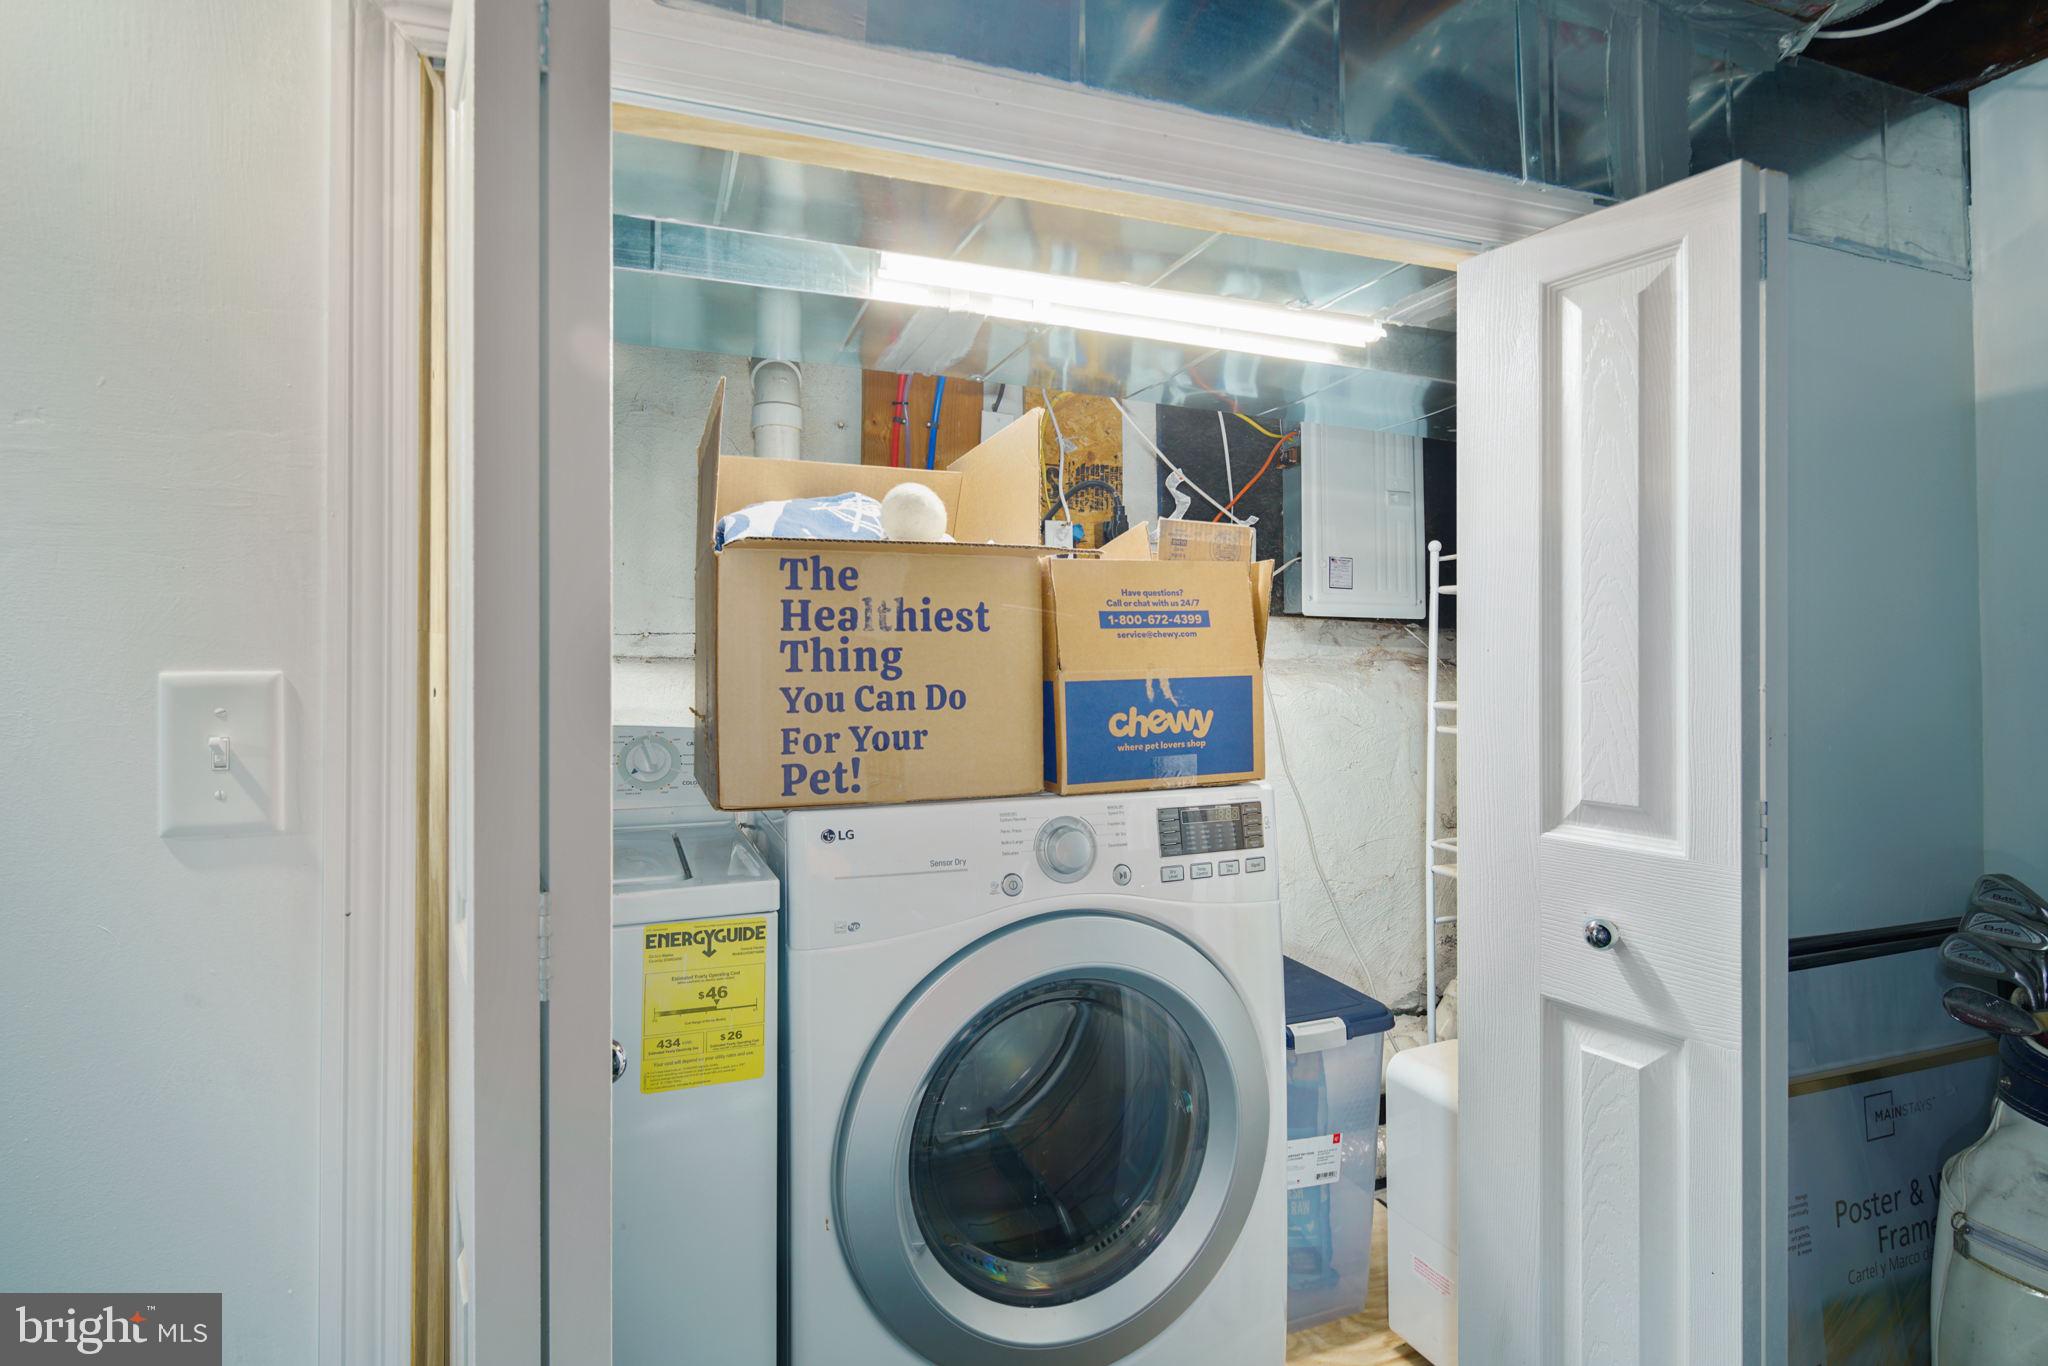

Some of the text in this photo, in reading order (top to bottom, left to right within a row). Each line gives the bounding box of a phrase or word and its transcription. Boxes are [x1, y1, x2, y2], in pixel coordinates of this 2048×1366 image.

[779, 555, 859, 591] The
[1106, 599, 1122, 607] Call
[1151, 599, 1169, 607] with
[1180, 599, 1200, 607] 24/7
[1121, 588, 1184, 598] Have questions?
[780, 596, 991, 632] Healthiest
[1107, 615, 1202, 625] 1-800-672-4399
[1117, 630, 1197, 640] service@chewy.com
[779, 636, 903, 681] Thing
[779, 684, 967, 714] You Can Do
[1108, 706, 1214, 738] chewy
[781, 725, 928, 755] For Your
[1117, 740, 1206, 752] where pet lovers shop
[781, 757, 861, 797] Pet!
[838, 829, 855, 841] LG
[929, 858, 967, 868] Sensor Dry
[645, 925, 767, 950] ENERGYGUIDE
[656, 1038, 681, 1049] 434
[1875, 1099, 1933, 1122] MAINSTAYS
[1835, 1189, 1901, 1228] Poster
[1910, 1179, 1924, 1206] &
[1848, 1259, 1878, 1285] Cartel
[1889, 1252, 1921, 1271] Marco
